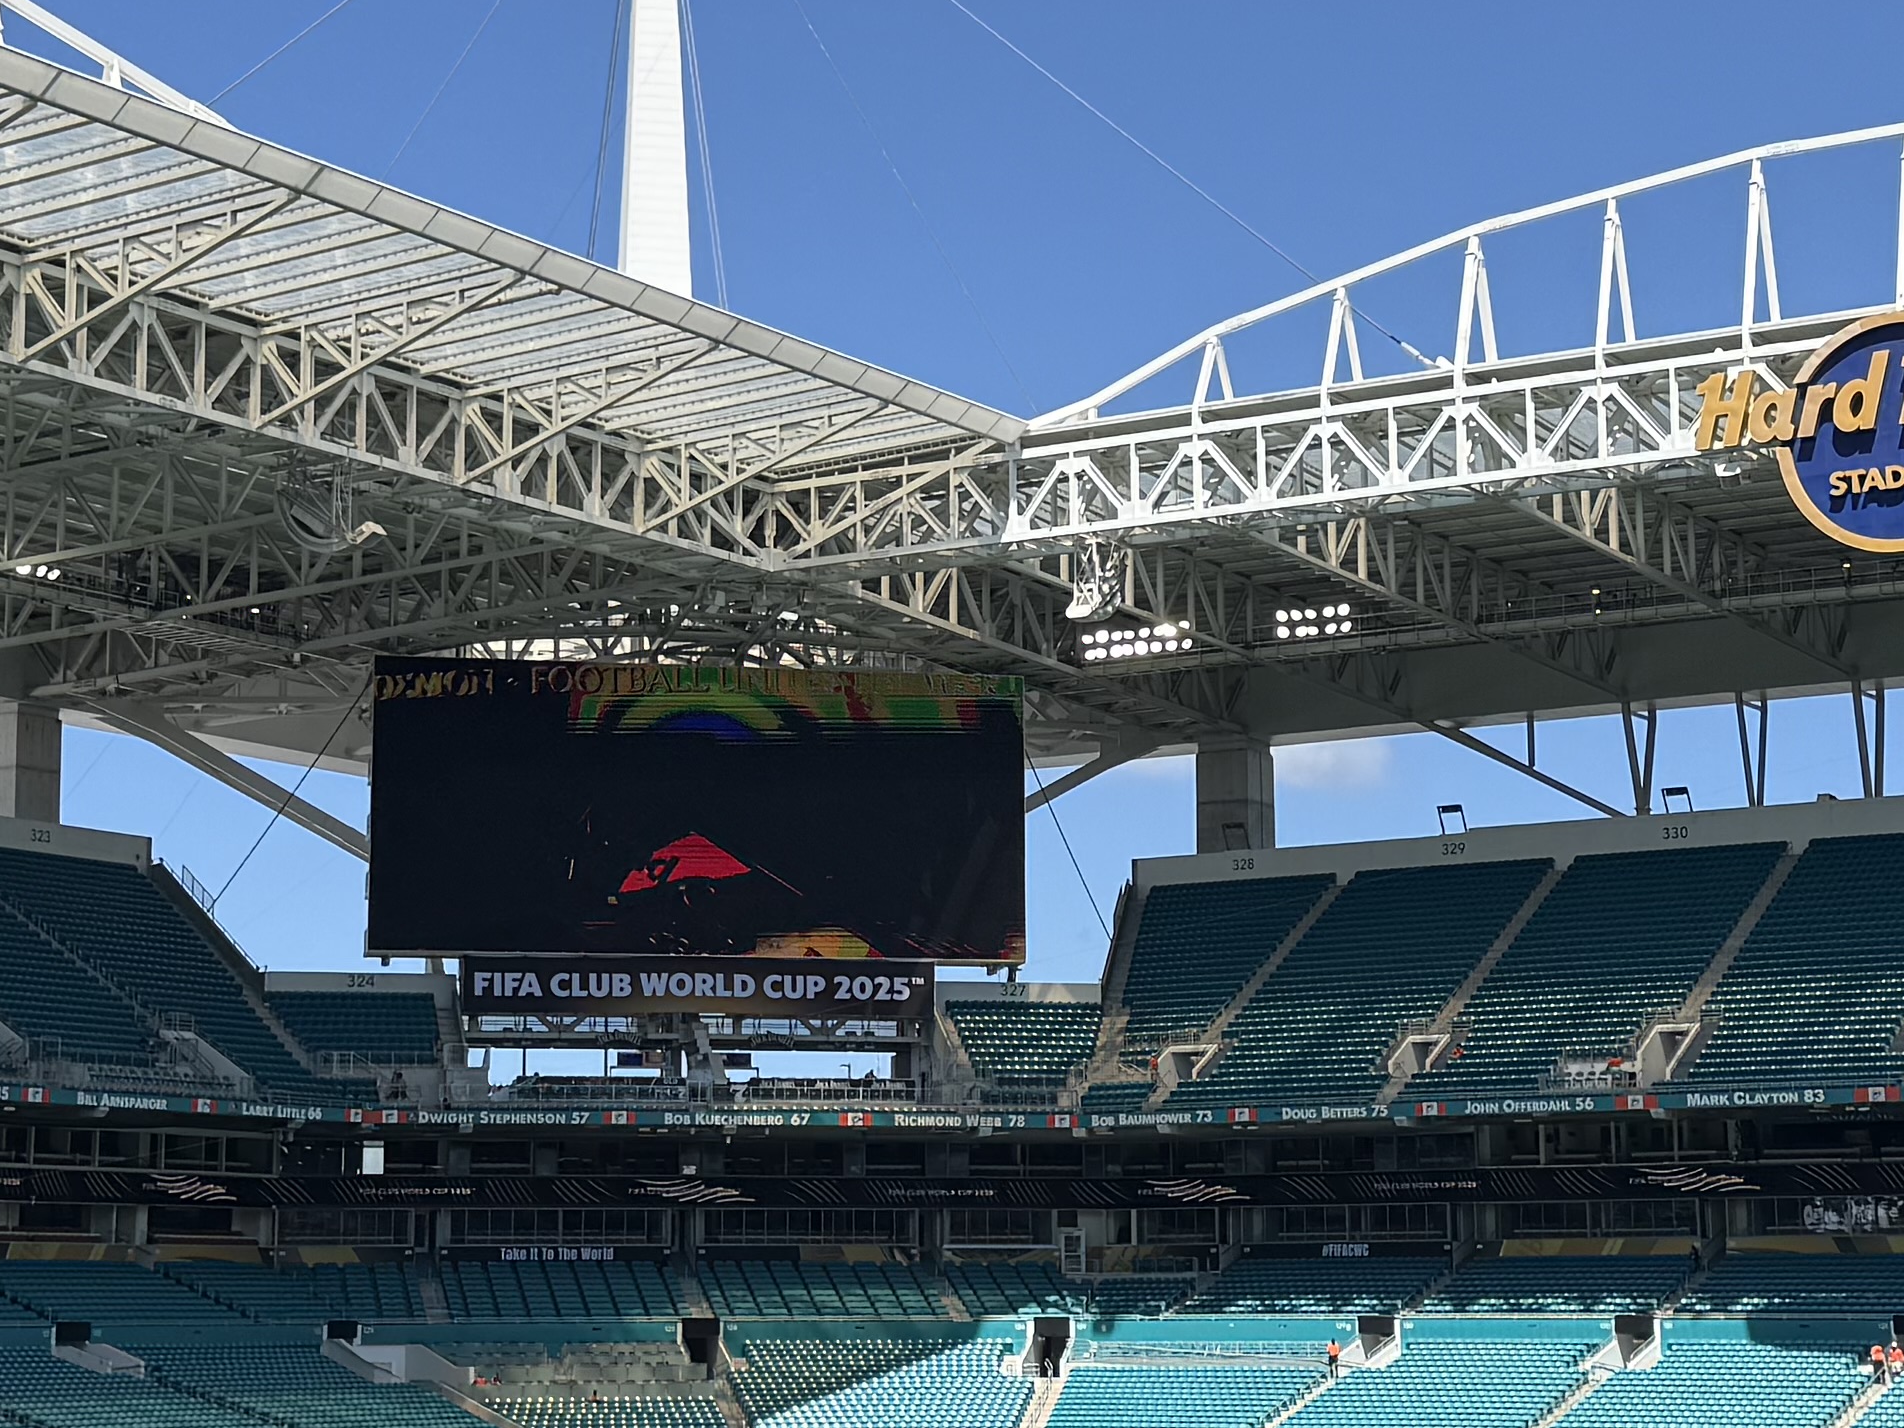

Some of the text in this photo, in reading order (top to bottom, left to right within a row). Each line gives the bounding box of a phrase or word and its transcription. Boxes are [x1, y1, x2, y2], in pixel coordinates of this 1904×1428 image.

[1695, 349, 1891, 451] Hard
[31, 828, 50, 843] 323
[1662, 826, 1688, 840] 330
[1442, 842, 1465, 856] 329
[1232, 858, 1254, 871] 328
[347, 975, 375, 988] 324
[474, 971, 543, 998] FIFA
[550, 972, 632, 999] CLUB
[639, 972, 755, 1000] WORLD
[762, 974, 826, 1000] CUP
[1000, 983, 1026, 996] 327
[1464, 1097, 1593, 1114] JOHN OFFERDAHL 56
[1687, 1090, 1825, 1108] MARK CLAYTON 83
[307, 1107, 323, 1120] 66
[418, 1111, 591, 1126] DWIGHT STEPHENSON 57
[1119, 1112, 1192, 1126] BAUMHOWER
[1196, 1110, 1212, 1123] 73
[1282, 1104, 1388, 1120] DOUG BETTERS 75
[664, 1113, 810, 1126] BOB KUECHENBERG 67
[895, 1114, 961, 1127] RICHMOND
[1008, 1115, 1025, 1127] 78
[500, 1247, 526, 1260] Take
[542, 1247, 555, 1260] To
[558, 1247, 578, 1260] The
[581, 1247, 613, 1260] World
